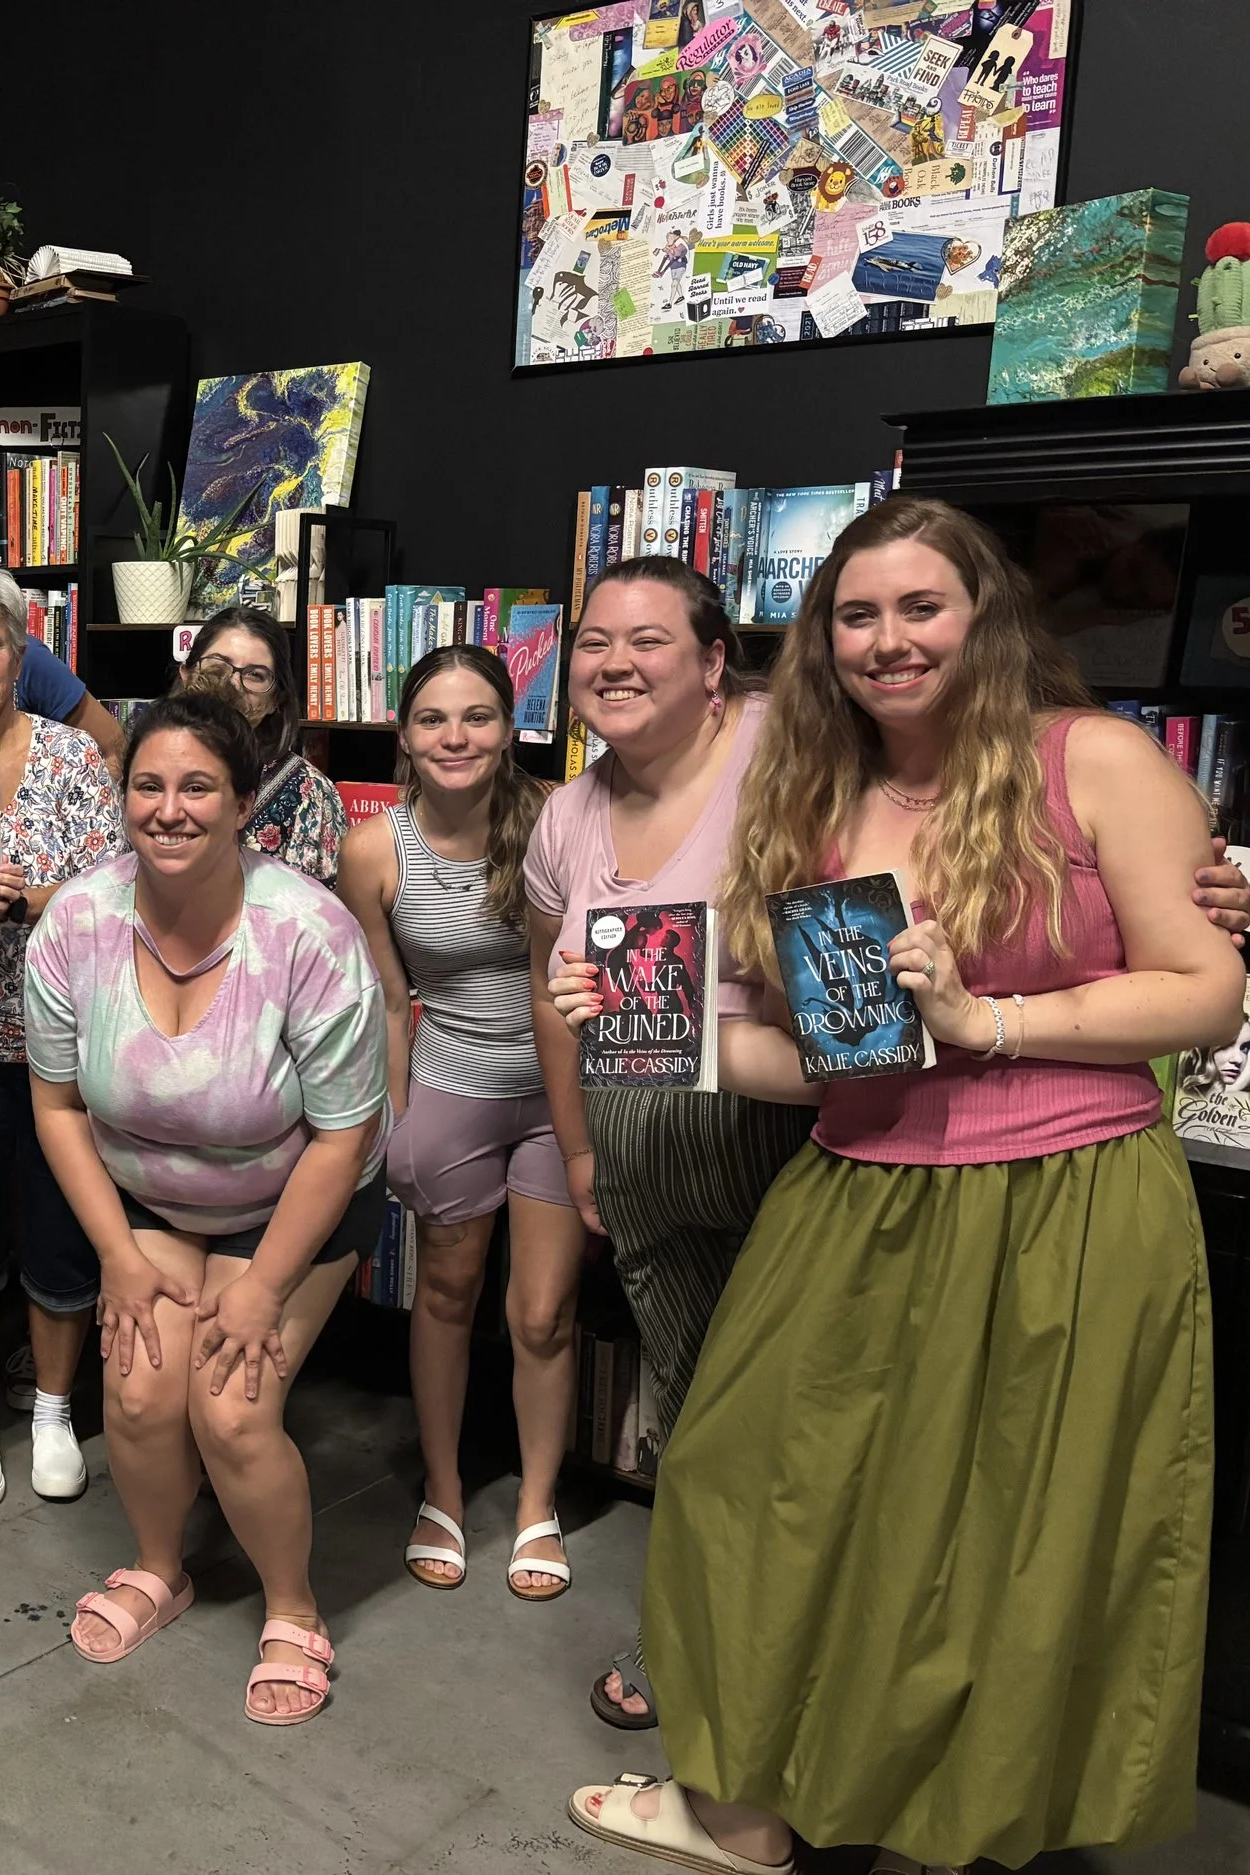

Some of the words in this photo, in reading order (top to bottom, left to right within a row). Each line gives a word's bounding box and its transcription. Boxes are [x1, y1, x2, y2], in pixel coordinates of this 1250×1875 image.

[923, 50, 951, 69] SEEK
[784, 68, 812, 83] ACADIA
[887, 75, 898, 83] Park
[900, 78, 912, 88] Road
[913, 82, 928, 93] Books
[913, 68, 940, 87] FIND
[1022, 86, 1032, 96] to
[1034, 81, 1057, 93] teach
[917, 169, 926, 189] Oak
[929, 165, 940, 190] Black
[717, 177, 725, 205] books.
[756, 181, 776, 198] JOKER
[709, 193, 717, 209] just
[585, 217, 630, 239] MetroCard
[715, 207, 723, 229] have
[863, 221, 886, 246] 158
[698, 240, 716, 248] Here's
[801, 262, 817, 283] READ
[713, 297, 734, 306] Until
[747, 294, 767, 303] read
[712, 307, 737, 316] again.
[803, 317, 811, 335] 2021
[699, 507, 707, 534] SMITTEN
[590, 524, 602, 543] NORA
[588, 545, 601, 575] ROBERTS
[764, 556, 825, 580] ARCHE
[310, 610, 318, 629] BOOK
[323, 609, 332, 629] BOOK
[482, 606, 491, 641] Moment
[490, 614, 498, 632] One
[310, 631, 318, 659] LOVERS
[323, 631, 332, 659] LOVERS
[509, 631, 556, 692] Pucked
[310, 664, 318, 683] EMILY
[310, 685, 318, 706] HENRY
[526, 698, 547, 711] HELENA
[523, 711, 546, 724] HUNTING
[1176, 723, 1185, 749] BEFORE
[350, 799, 390, 813] ABBY
[818, 931, 832, 947] IN
[838, 925, 865, 944] THE
[626, 949, 637, 963] IN
[642, 947, 668, 962] THE
[803, 945, 887, 982] VEINS
[605, 964, 684, 993] WAKE
[826, 985, 848, 1003] OF
[854, 981, 882, 999] THE
[619, 996, 642, 1011] OF
[645, 995, 670, 1010] THE
[794, 1000, 916, 1036] DROWNING
[598, 1012, 690, 1045] RUINED
[585, 1057, 628, 1074] KALIE
[631, 1056, 699, 1074] CASSIDY
[805, 1052, 853, 1075] KALIE
[854, 1043, 921, 1068] CASSIDY
[1209, 1093, 1229, 1106] the
[1173, 1097, 1238, 1131] Golden
